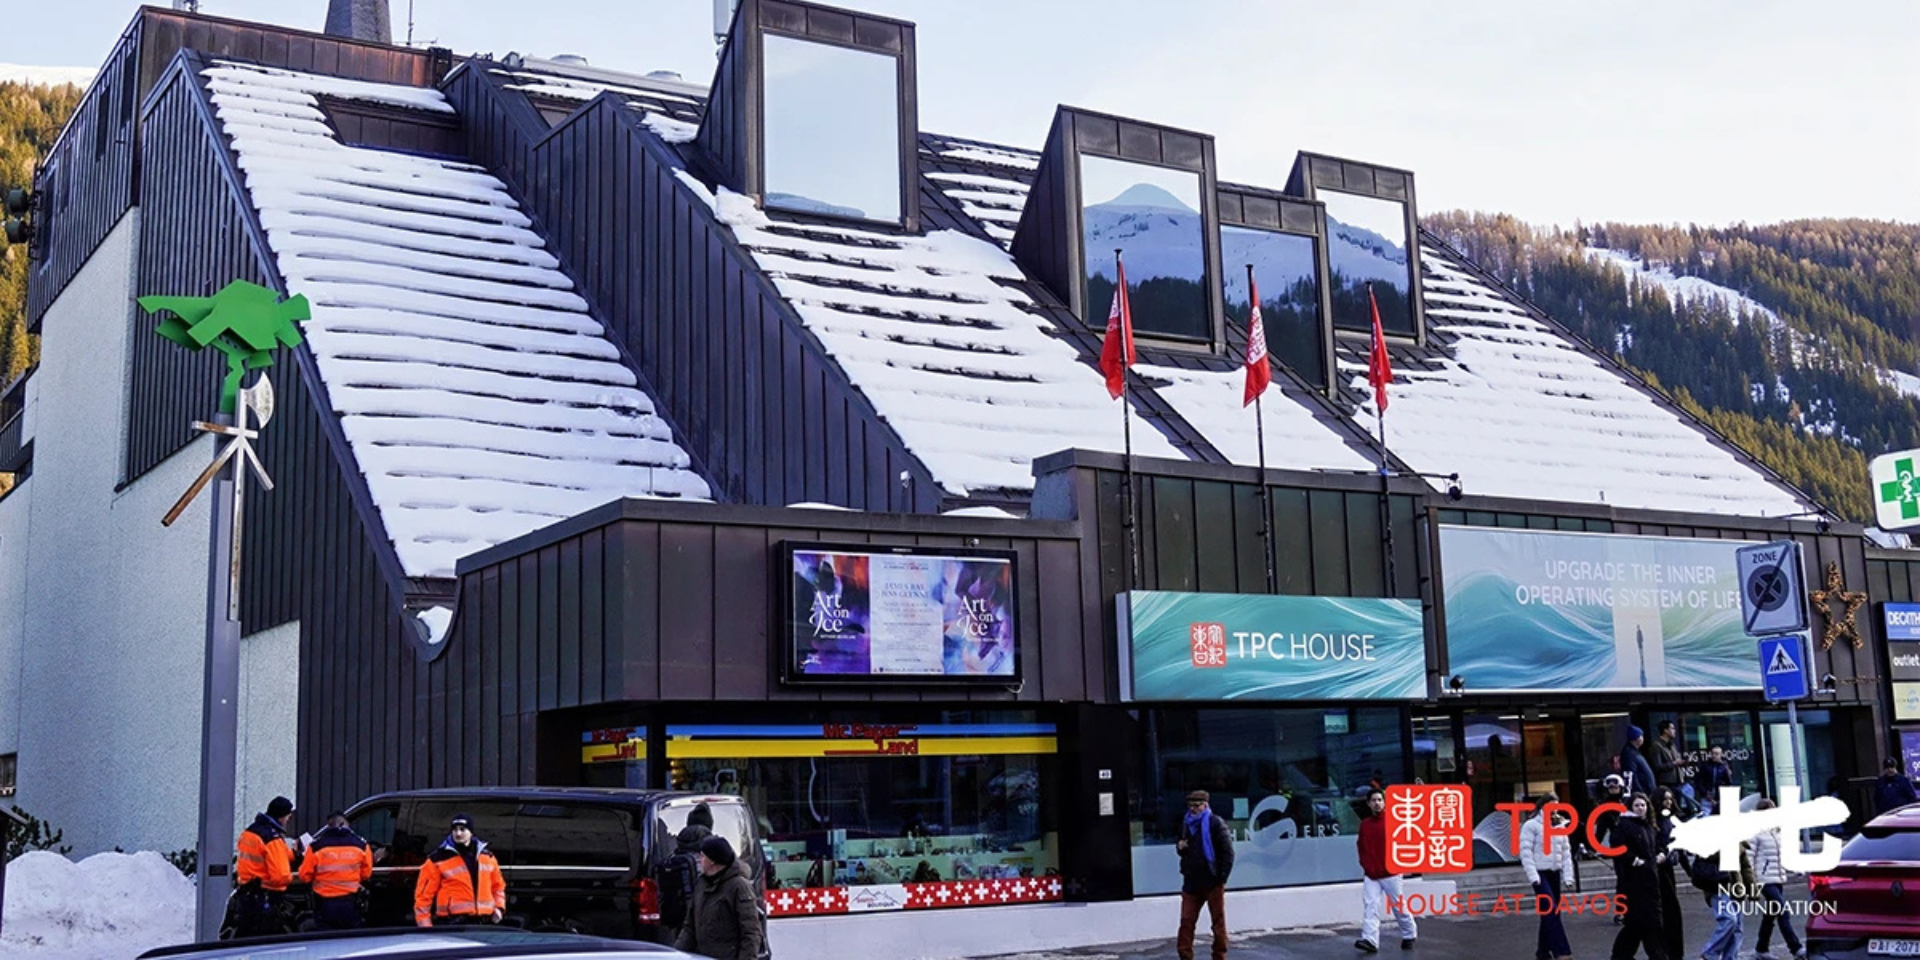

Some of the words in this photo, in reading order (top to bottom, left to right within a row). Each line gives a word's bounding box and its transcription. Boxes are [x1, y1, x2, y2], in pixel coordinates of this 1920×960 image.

[1752, 551, 1777, 563] ZONE
[1544, 560, 1625, 582] UPGRADE
[1631, 563, 1663, 583] THE
[1668, 565, 1716, 584] INNER
[810, 590, 842, 617] Art
[957, 595, 987, 621] Art
[1515, 585, 1614, 606] OPERATING
[1619, 588, 1682, 608] SYSTEM
[1687, 590, 1708, 608] OF
[809, 611, 843, 637] Ice
[833, 609, 849, 618] on
[979, 613, 994, 622] on
[956, 615, 988, 639] Ice
[1233, 632, 1285, 660] TPC
[1290, 633, 1377, 661] HOUSE
[878, 739, 919, 754] Land
